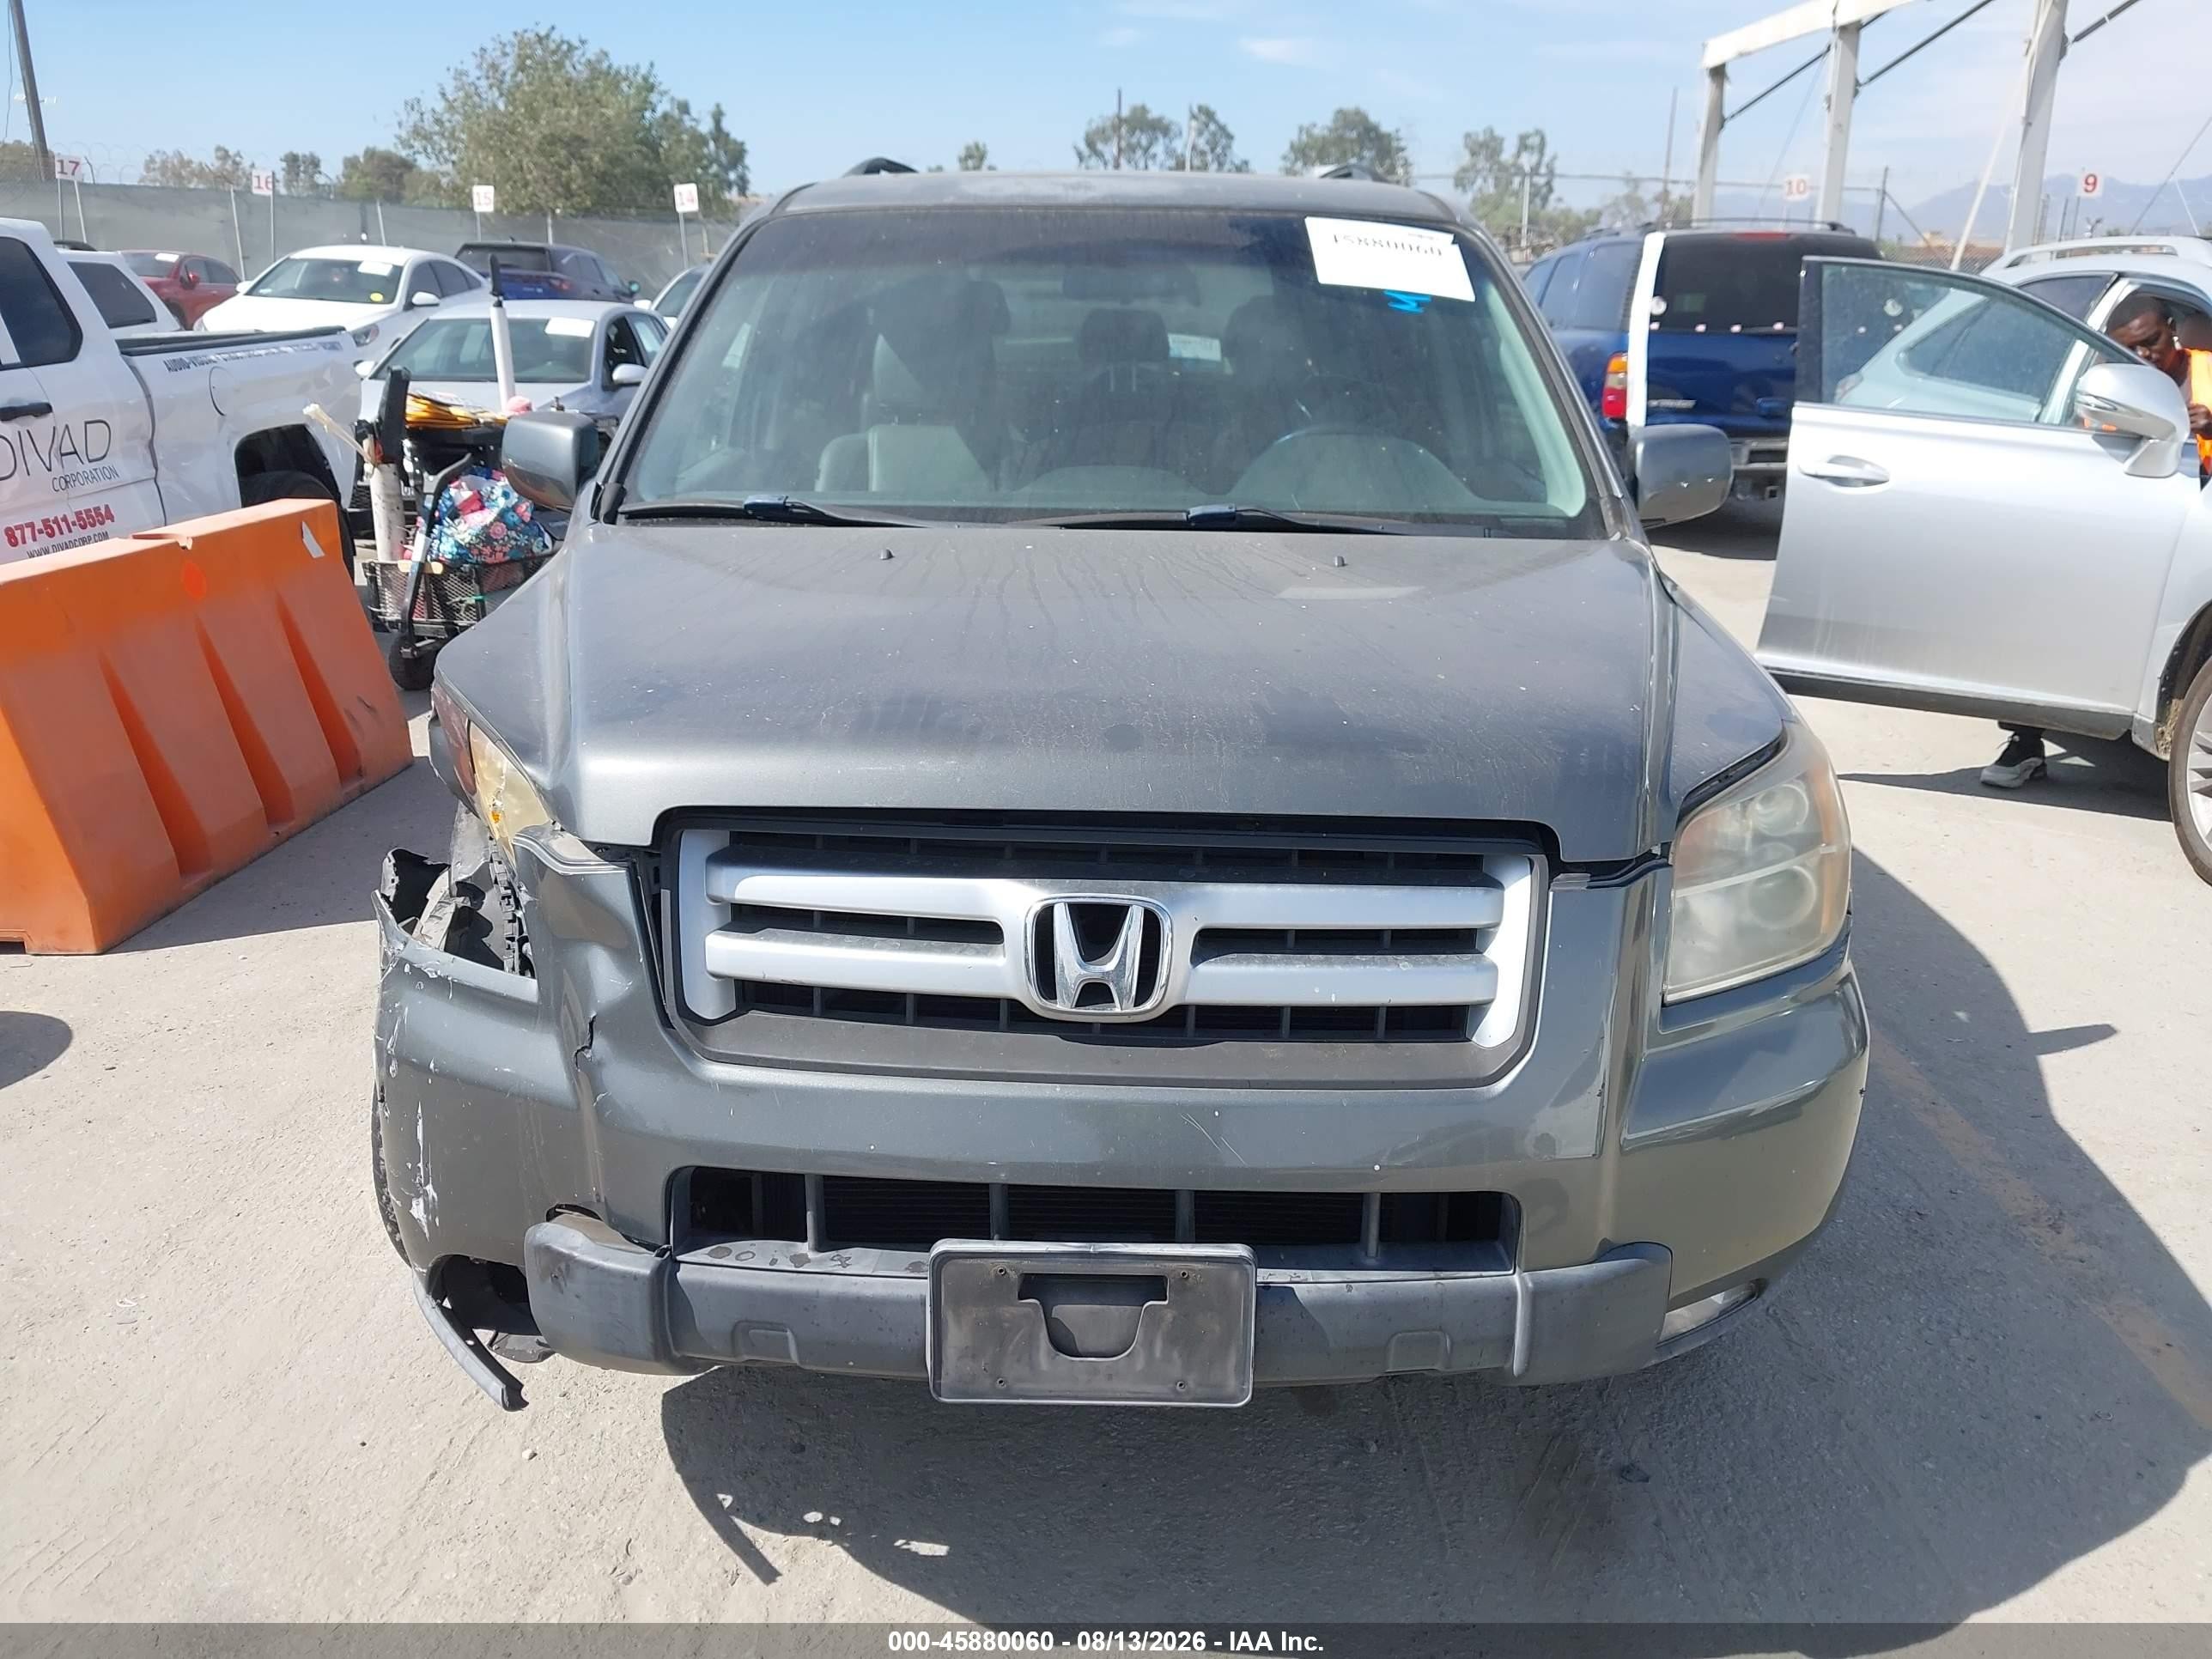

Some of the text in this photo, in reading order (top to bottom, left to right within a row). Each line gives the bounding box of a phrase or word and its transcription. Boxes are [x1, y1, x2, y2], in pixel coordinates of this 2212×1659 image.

[57, 158, 80, 176] 17
[253, 174, 273, 191] 16
[1785, 178, 1808, 196] 10
[2084, 173, 2098, 193] 9
[476, 191, 492, 206] 15
[0, 419, 112, 481] DIVAD
[52, 465, 119, 492] CORPORATION
[4, 504, 115, 547] 877-511-5554
